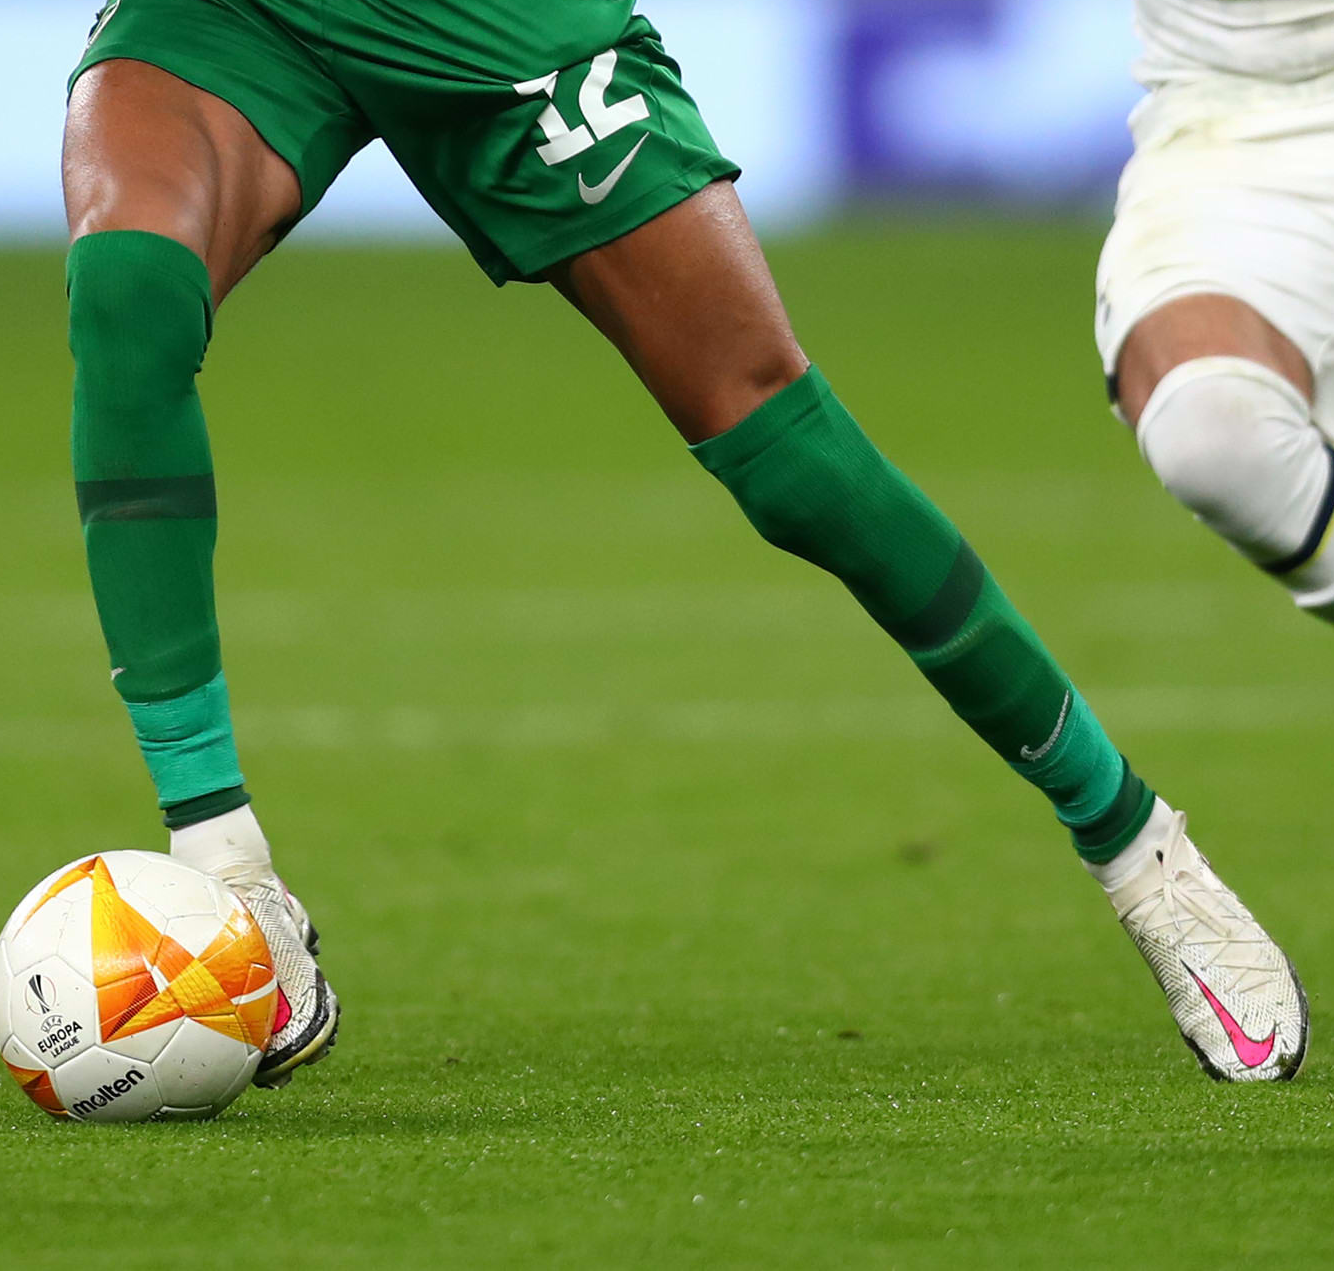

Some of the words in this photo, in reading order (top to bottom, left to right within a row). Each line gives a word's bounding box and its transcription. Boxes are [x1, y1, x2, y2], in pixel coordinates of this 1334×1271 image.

[512, 48, 650, 167] 12
[37, 1020, 83, 1054] EUROPA
[50, 1035, 80, 1058] LEAGUE
[72, 1069, 145, 1116] molten
